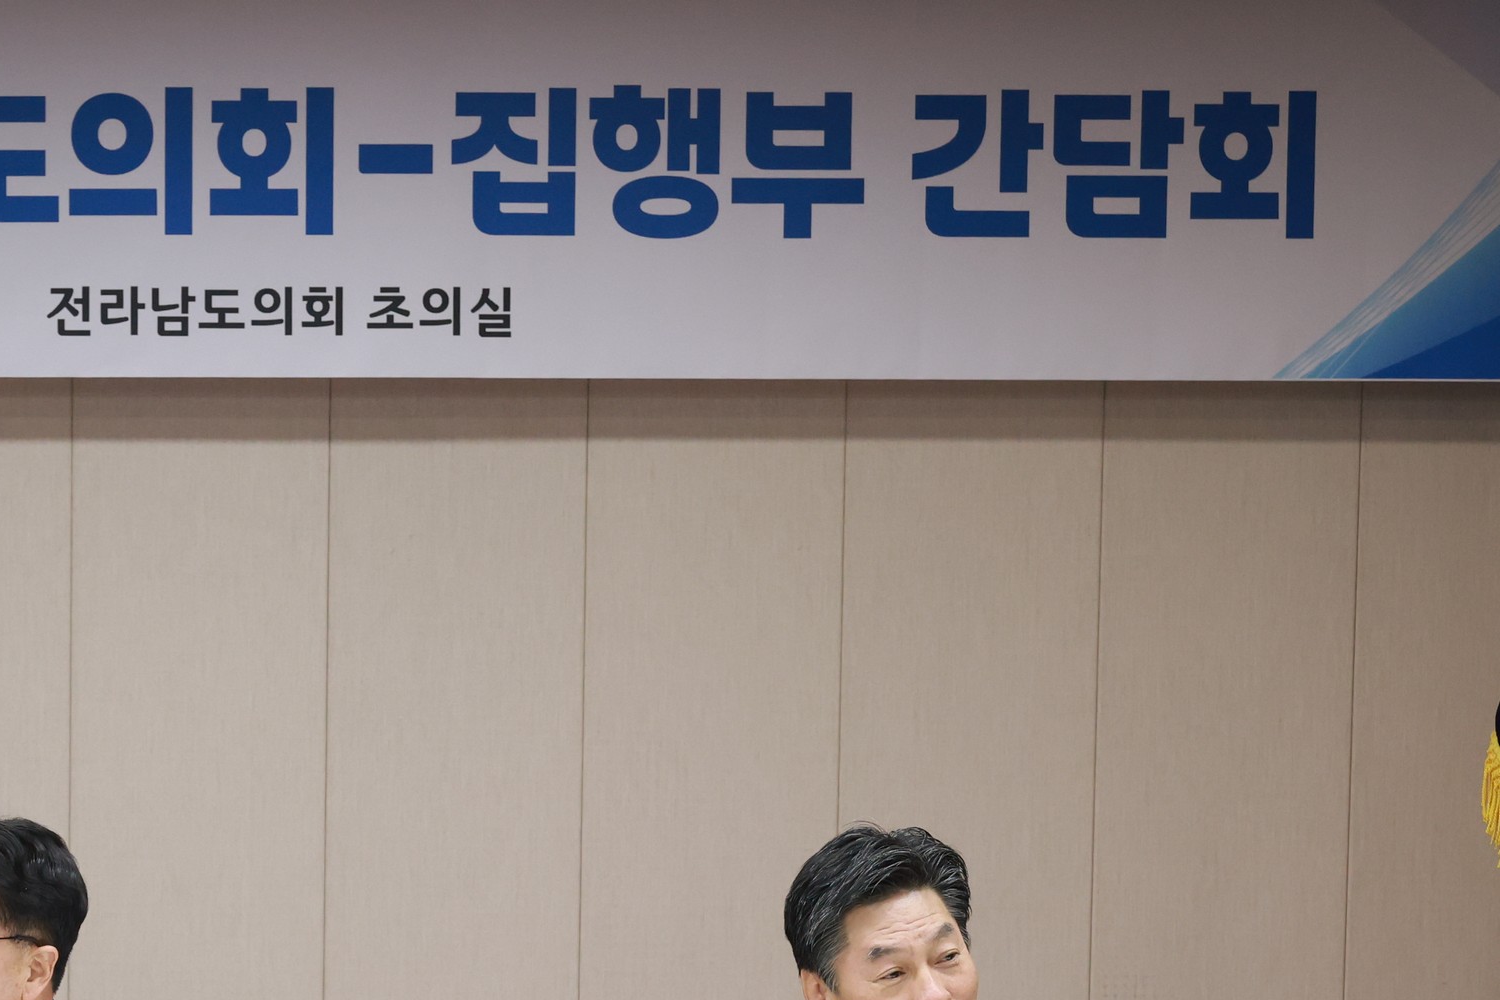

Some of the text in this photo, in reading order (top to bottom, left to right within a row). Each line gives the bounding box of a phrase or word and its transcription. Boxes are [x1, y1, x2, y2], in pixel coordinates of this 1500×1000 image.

[912, 89, 1317, 239] 간담회
[47, 286, 511, 337] 전라남도의회 초의실
